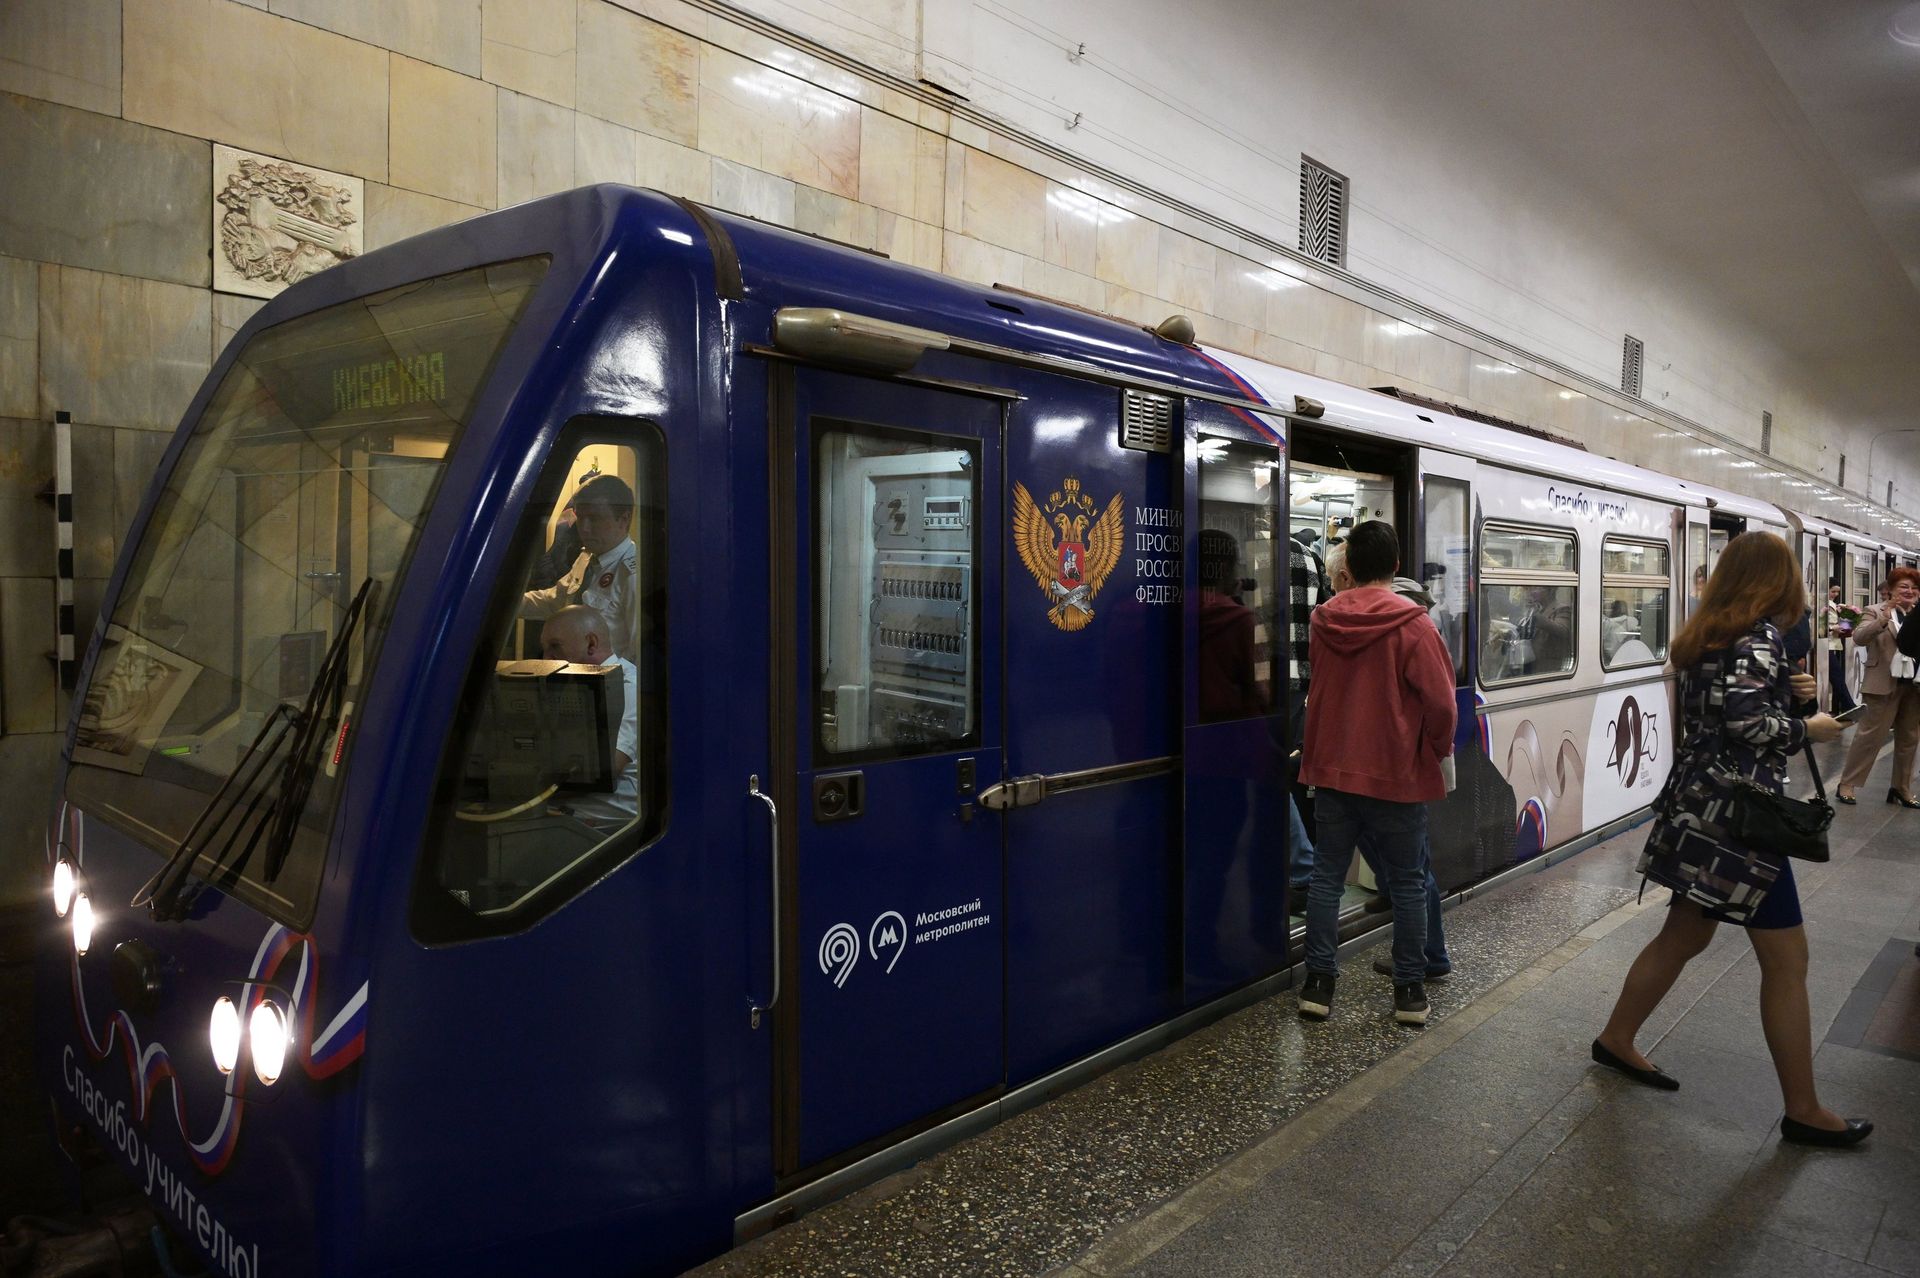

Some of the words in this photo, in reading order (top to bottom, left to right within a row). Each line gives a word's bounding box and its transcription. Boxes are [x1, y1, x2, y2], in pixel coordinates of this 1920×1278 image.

[332, 351, 446, 411] КИЕВСКАЯ
[1548, 485, 1589, 516] Спасибо
[915, 898, 982, 927] Московский
[915, 914, 990, 945] метрополитен
[63, 1044, 139, 1167] Спасибо
[144, 1143, 259, 1278] учителю!
